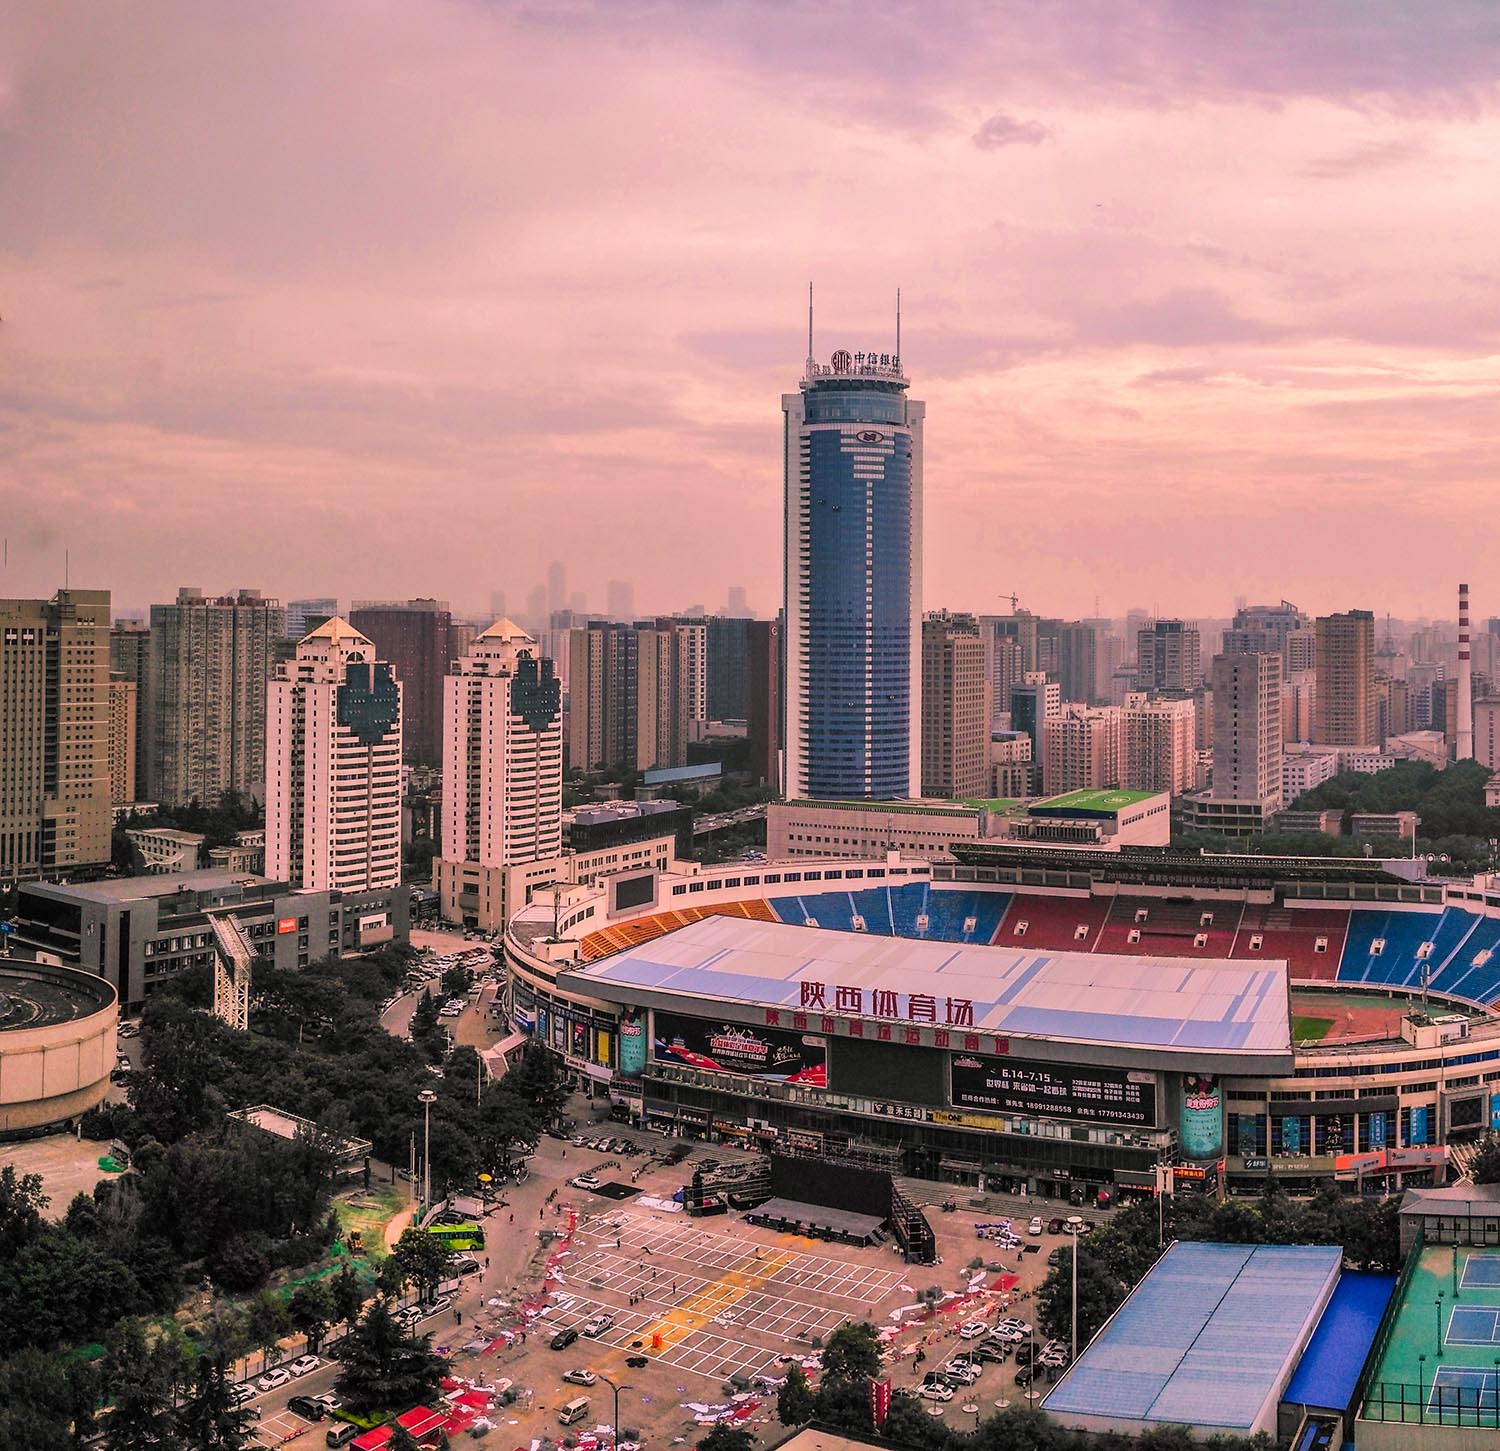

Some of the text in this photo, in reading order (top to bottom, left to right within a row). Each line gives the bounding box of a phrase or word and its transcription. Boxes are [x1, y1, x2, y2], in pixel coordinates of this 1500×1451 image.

[800, 981, 973, 1026] 陕西体育场
[1002, 1069, 1051, 1083] 6.14-7.15
